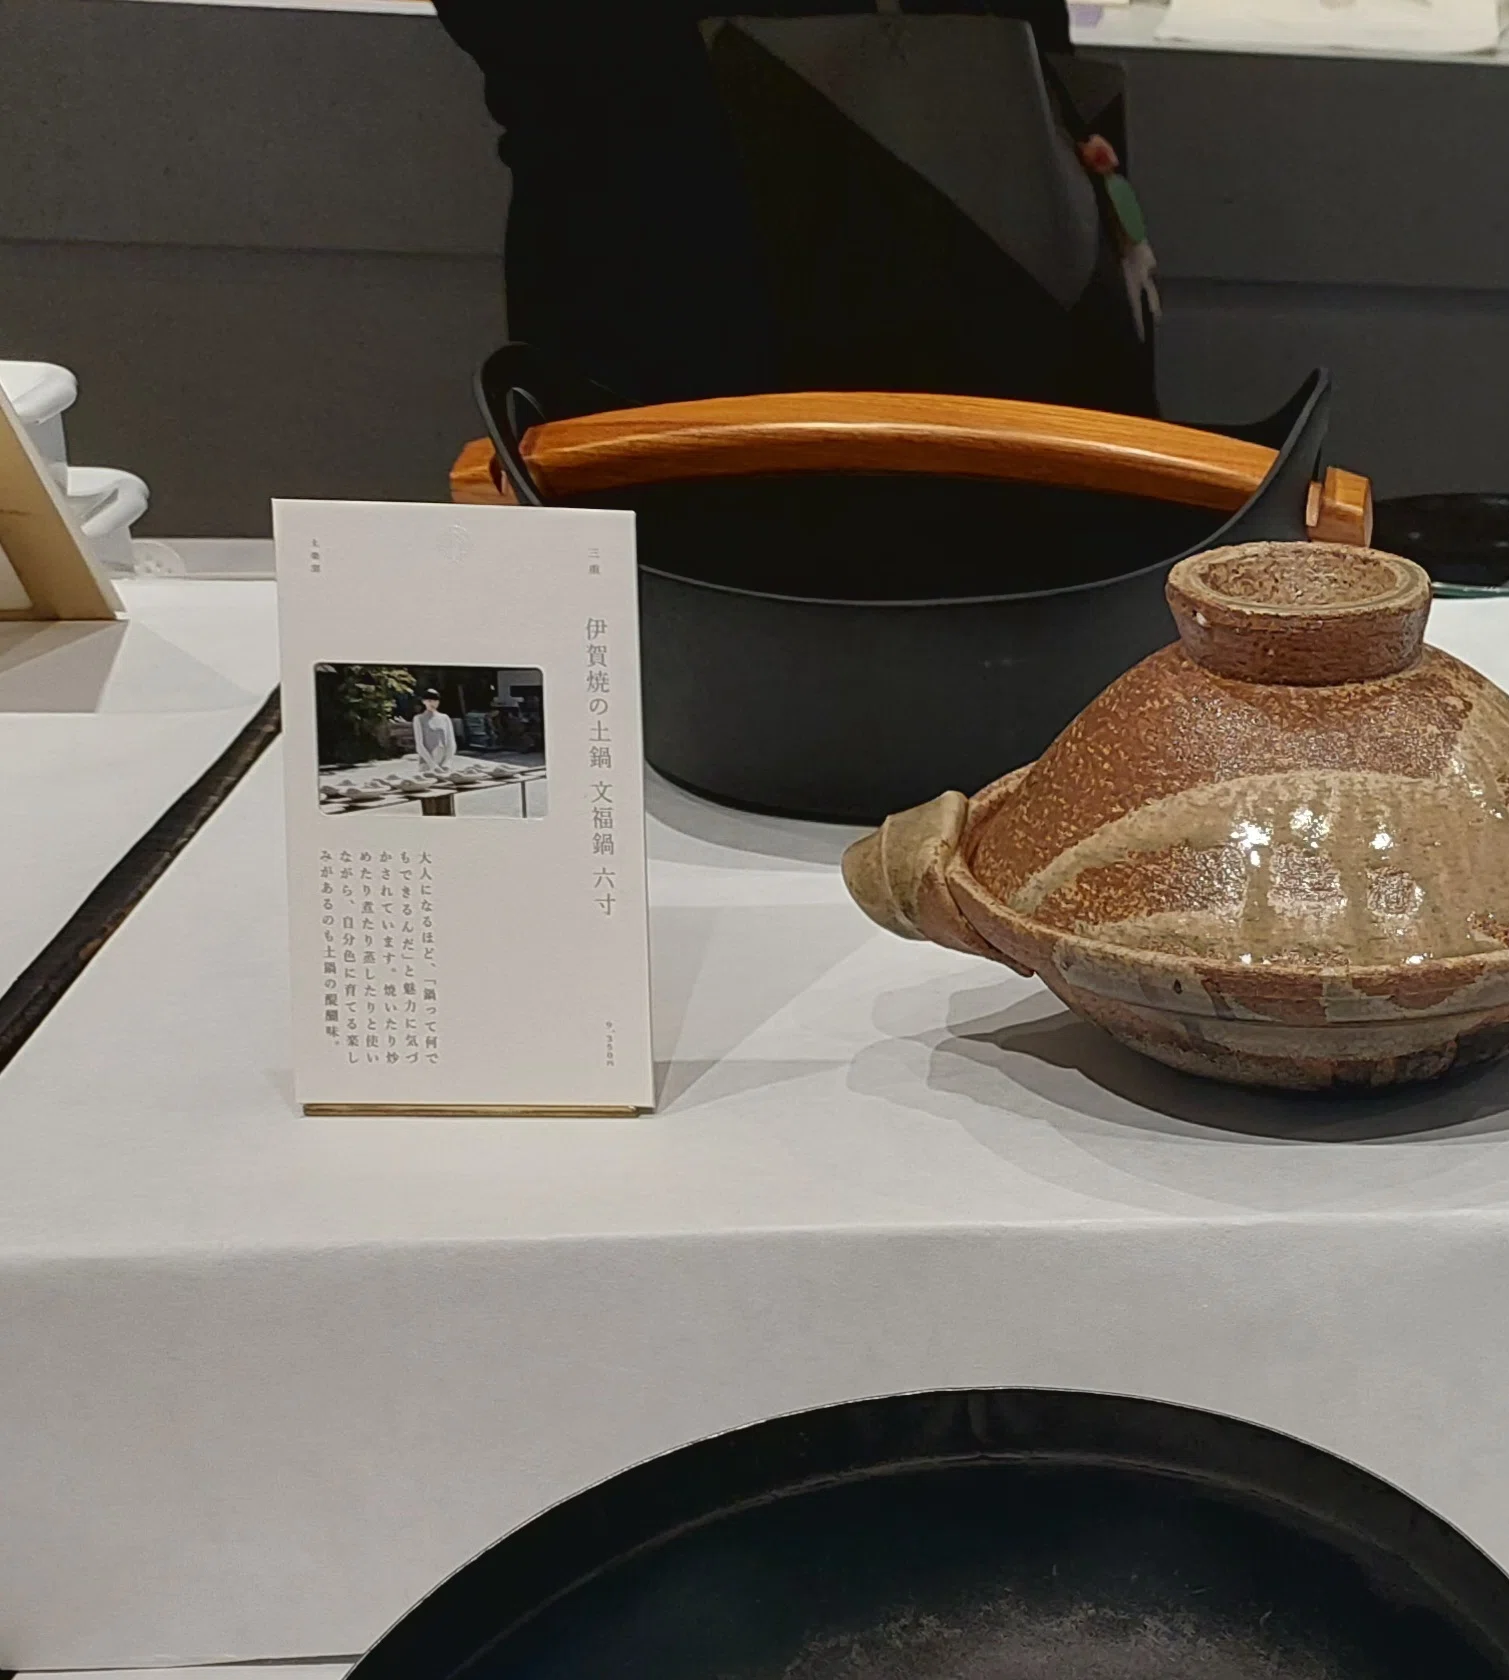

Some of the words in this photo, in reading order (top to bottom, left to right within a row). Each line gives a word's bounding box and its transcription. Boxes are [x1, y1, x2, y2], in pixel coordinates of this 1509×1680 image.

[584, 617, 612, 770] 伊賀焼の土鍋
[589, 780, 616, 856] 文福鍋
[593, 867, 617, 917] 六寸
[339, 850, 359, 1064] ながら、自分色に育てる楽し
[359, 851, 379, 1063] めたり煮たり蒸したりと使い
[380, 851, 399, 1064] かされています。焼いたり炒
